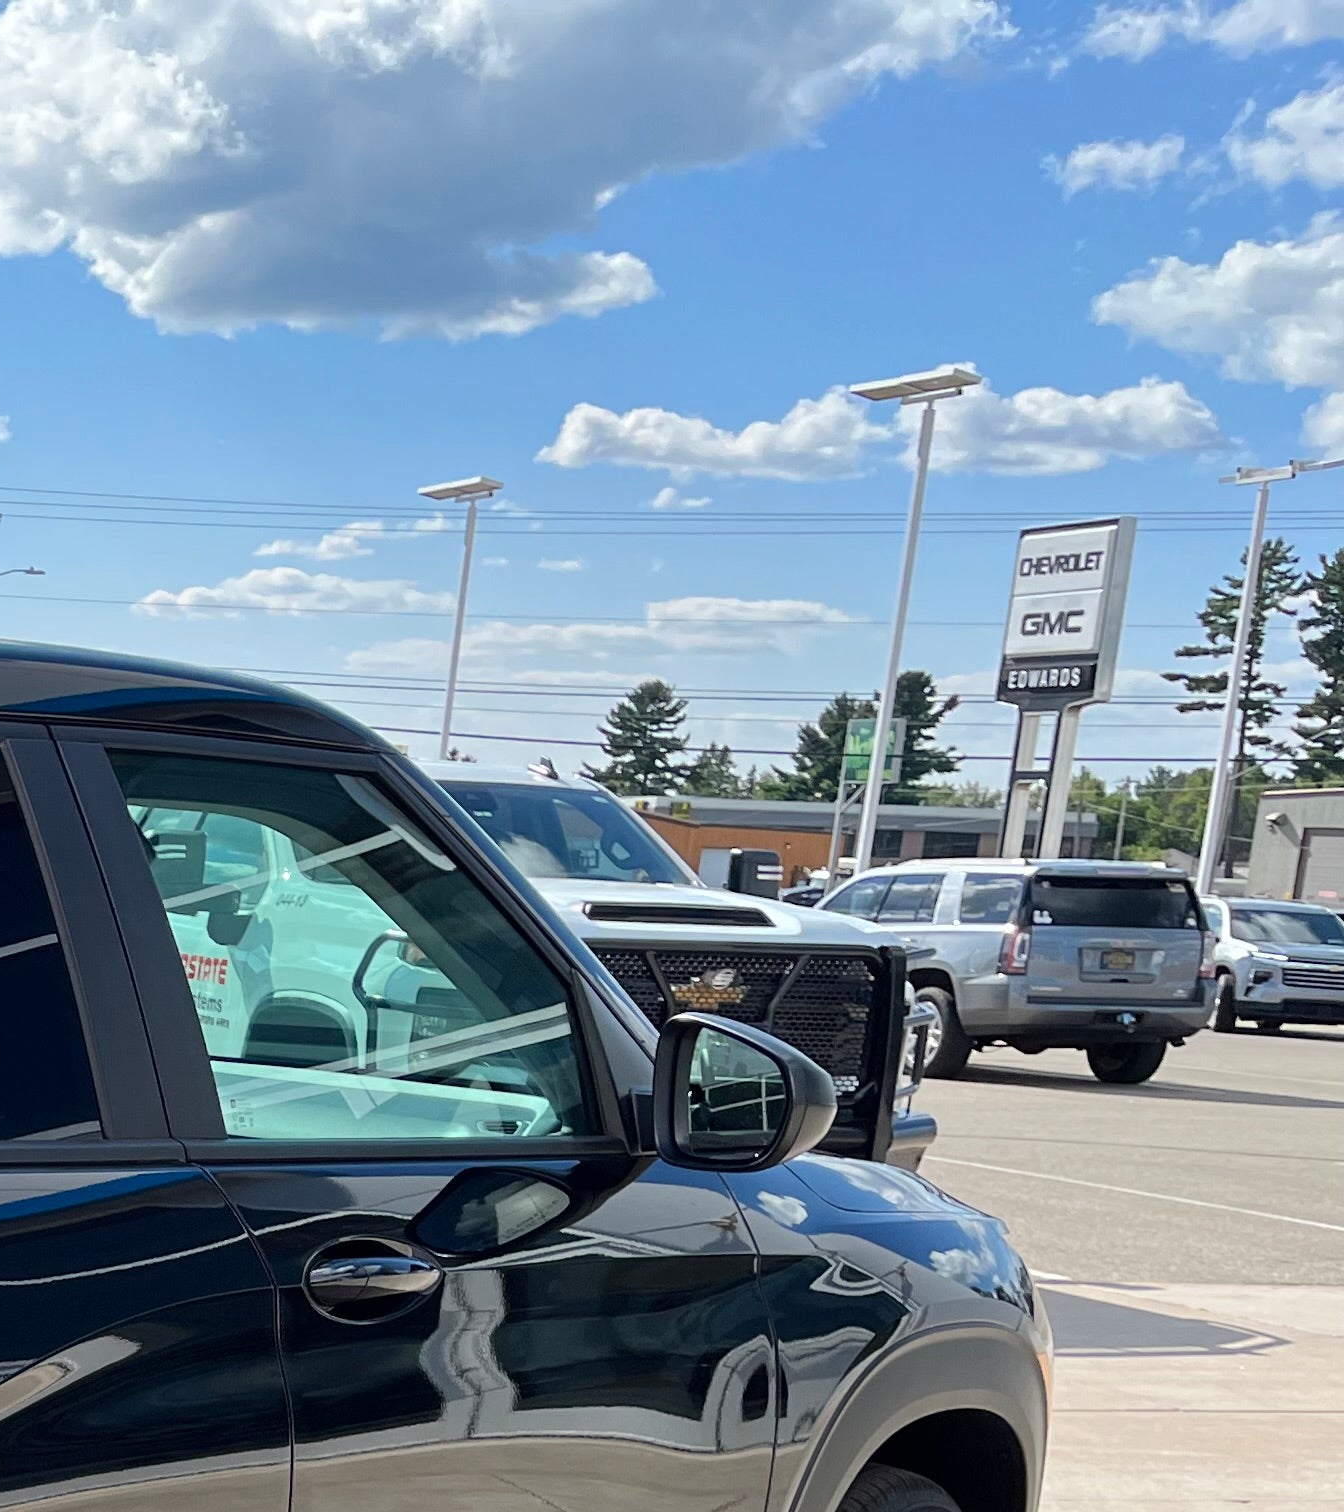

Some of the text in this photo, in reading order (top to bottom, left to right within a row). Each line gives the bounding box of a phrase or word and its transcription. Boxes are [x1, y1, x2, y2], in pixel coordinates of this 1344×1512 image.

[1019, 551, 1104, 577] CHEVROLET
[1021, 609, 1085, 636] GMC
[1007, 667, 1081, 689] EDWARDS
